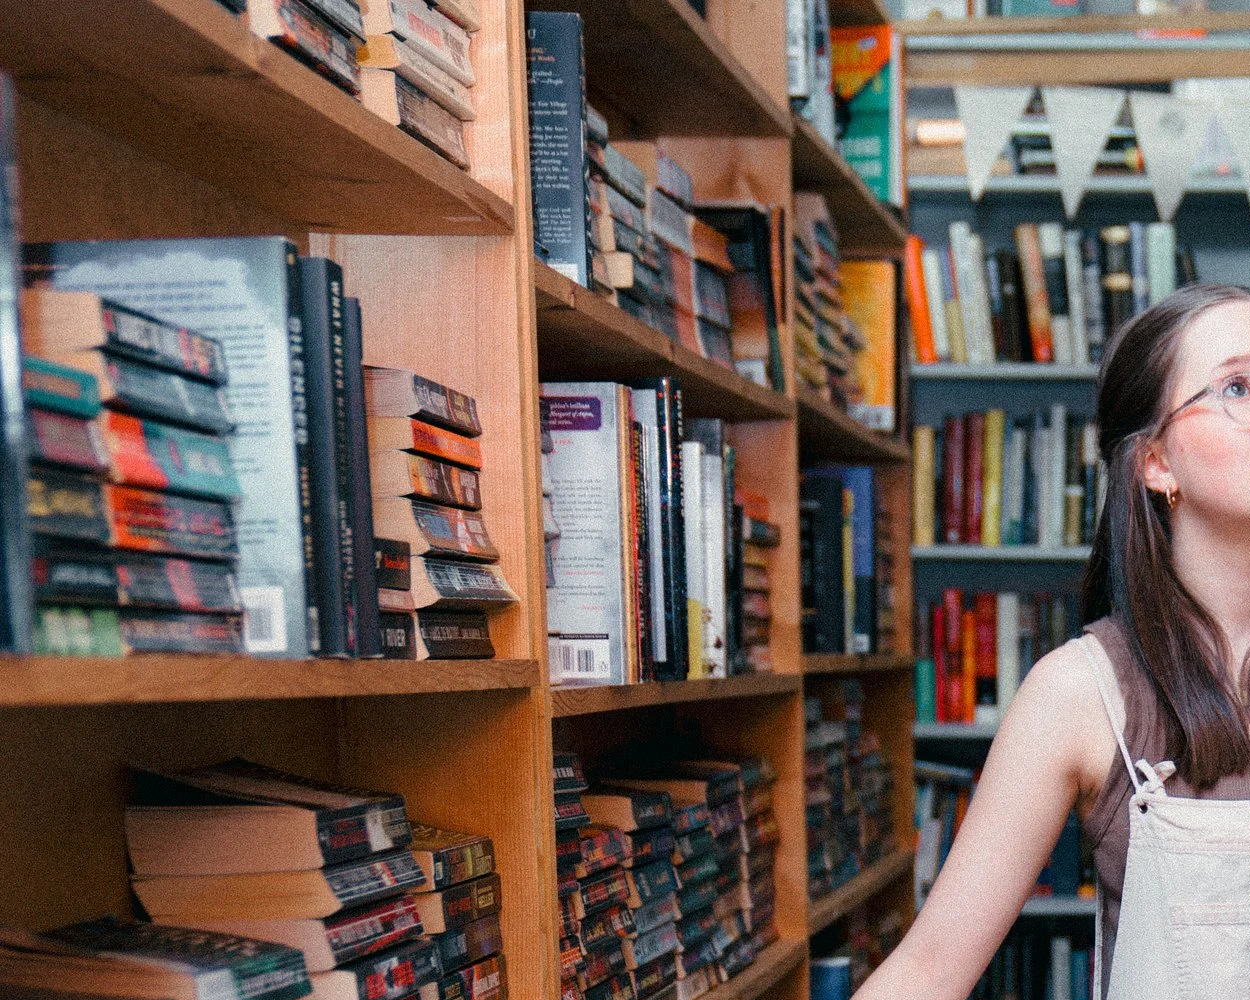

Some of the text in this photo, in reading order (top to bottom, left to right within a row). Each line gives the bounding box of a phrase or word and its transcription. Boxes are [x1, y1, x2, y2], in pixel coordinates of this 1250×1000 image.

[330, 281, 342, 329] WHAT
[333, 334, 344, 389] NEVER
[386, 628, 407, 647] RIVER
